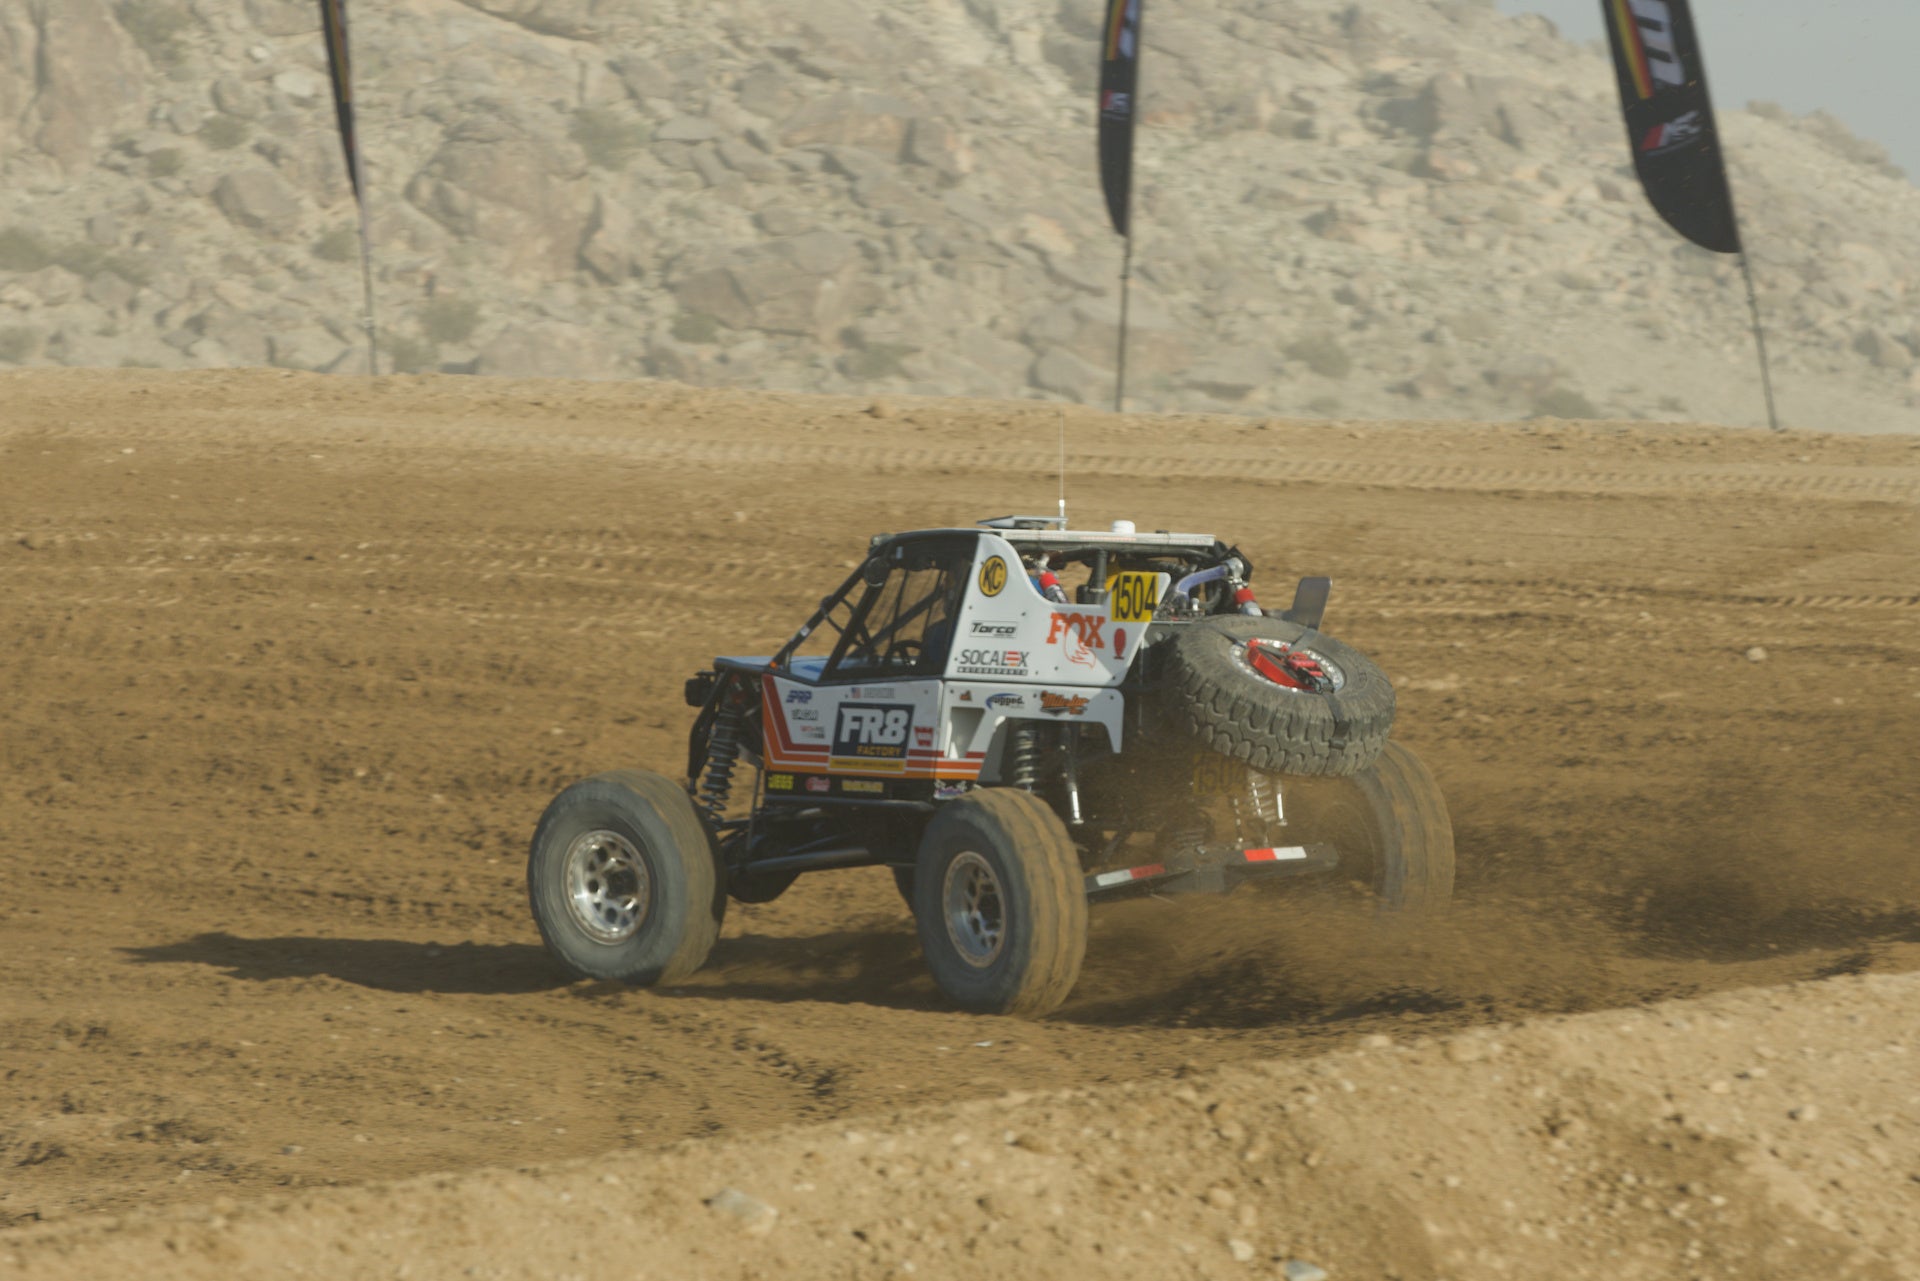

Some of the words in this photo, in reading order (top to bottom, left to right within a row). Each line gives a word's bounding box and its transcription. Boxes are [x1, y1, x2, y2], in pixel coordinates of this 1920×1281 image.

[982, 563, 1003, 592] KC
[1113, 575, 1159, 620] 1504
[972, 622, 1016, 634] Torco
[1046, 613, 1106, 649] FOX
[840, 708, 909, 744] FR8
[857, 745, 902, 756] FACTORY
